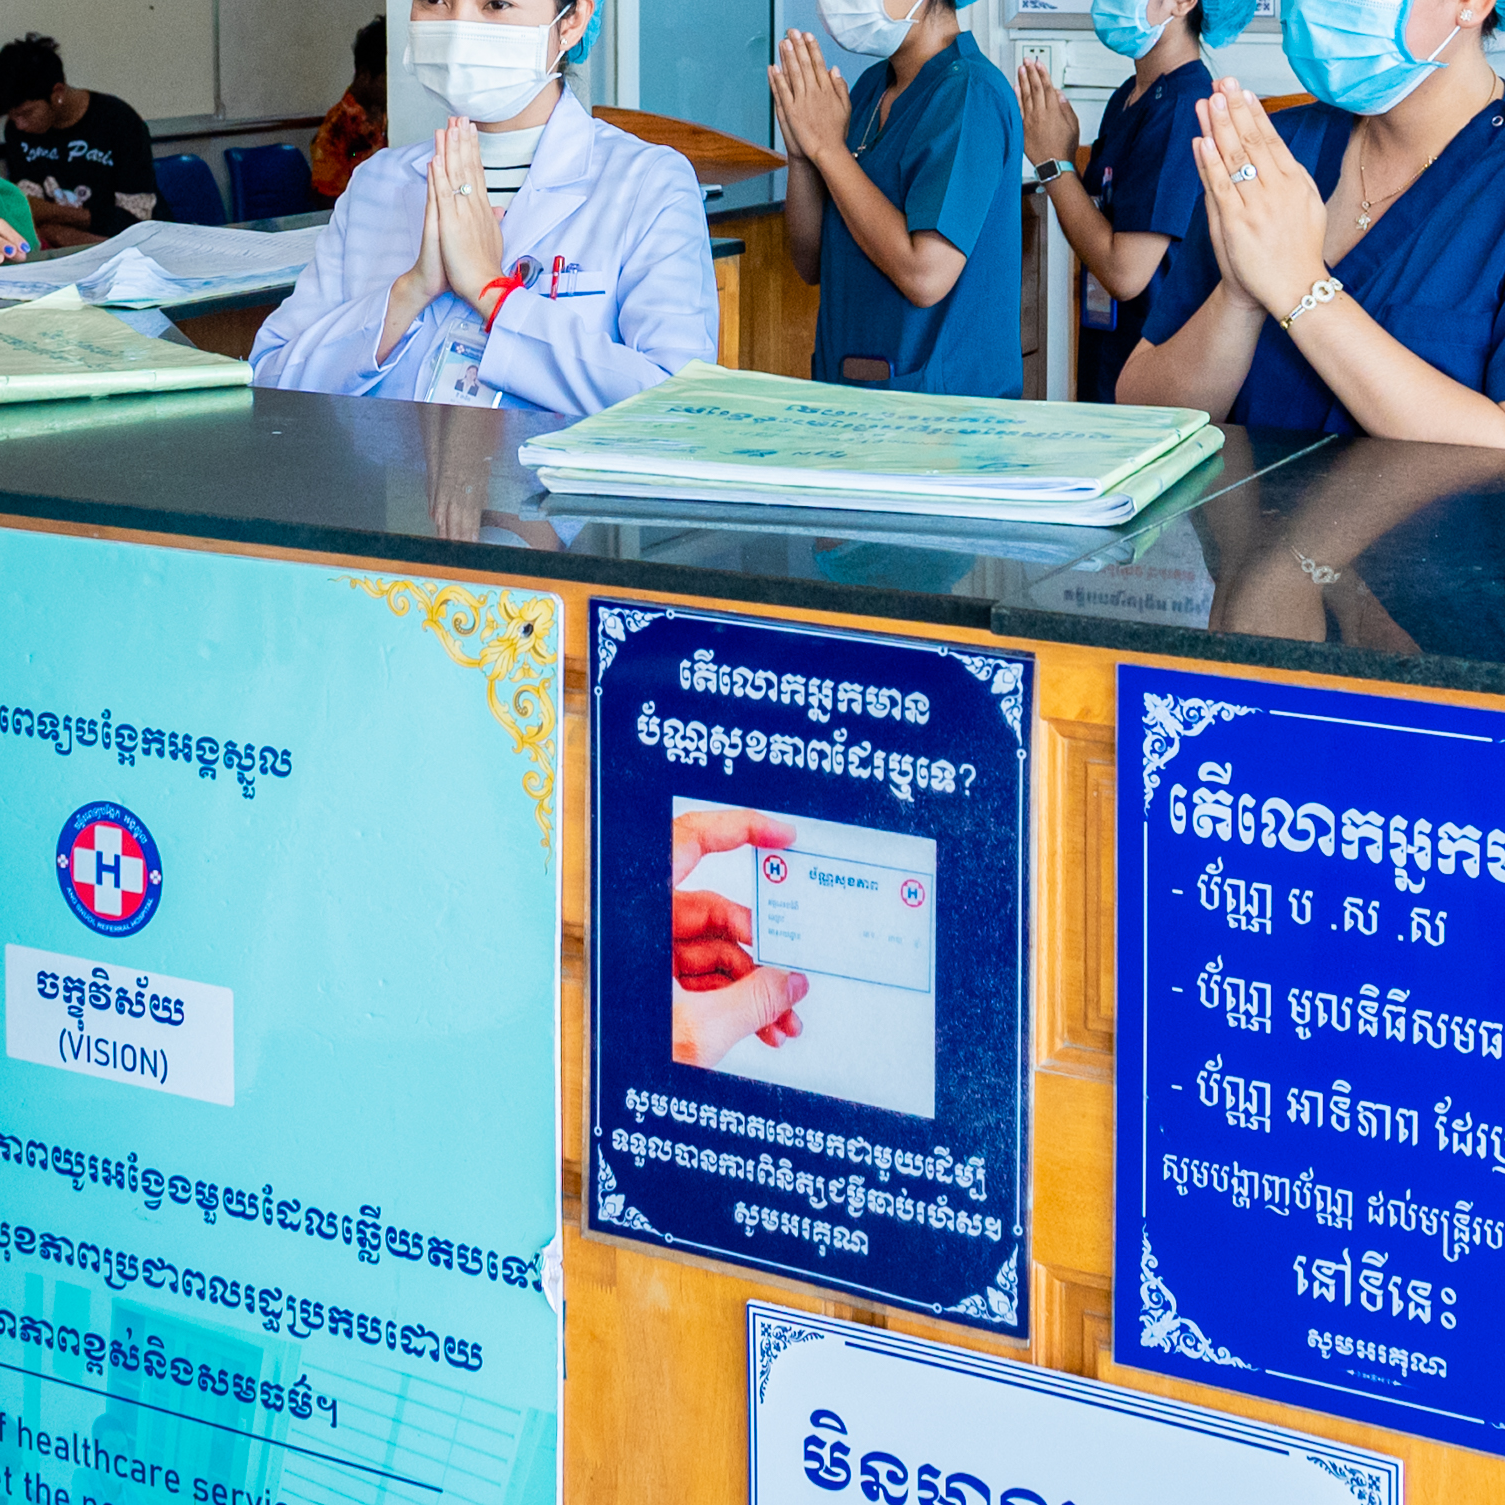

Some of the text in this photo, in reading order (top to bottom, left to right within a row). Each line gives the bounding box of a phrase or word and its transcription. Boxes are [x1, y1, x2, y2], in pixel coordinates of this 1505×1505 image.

[679, 648, 930, 725] តើលោកអ្នកមាន
[1195, 856, 1273, 935] ប័ណ្ណ
[1287, 886, 1314, 925] ប
[36, 966, 185, 1032] ចក្ខុវិស័យ
[1195, 955, 1273, 1034] ប័ណ្ណ
[59, 1027, 169, 1085] (VISION)
[1195, 1053, 1272, 1134] ប័ណ្ណ
[1286, 1078, 1420, 1146] អាទិភាព
[734, 1199, 869, 1257] សូមអរគុណ
[1292, 1247, 1458, 1331] នៅទីនេះ
[1307, 1327, 1448, 1379] សូមអរគុណ
[17, 1417, 181, 1495] healthcare
